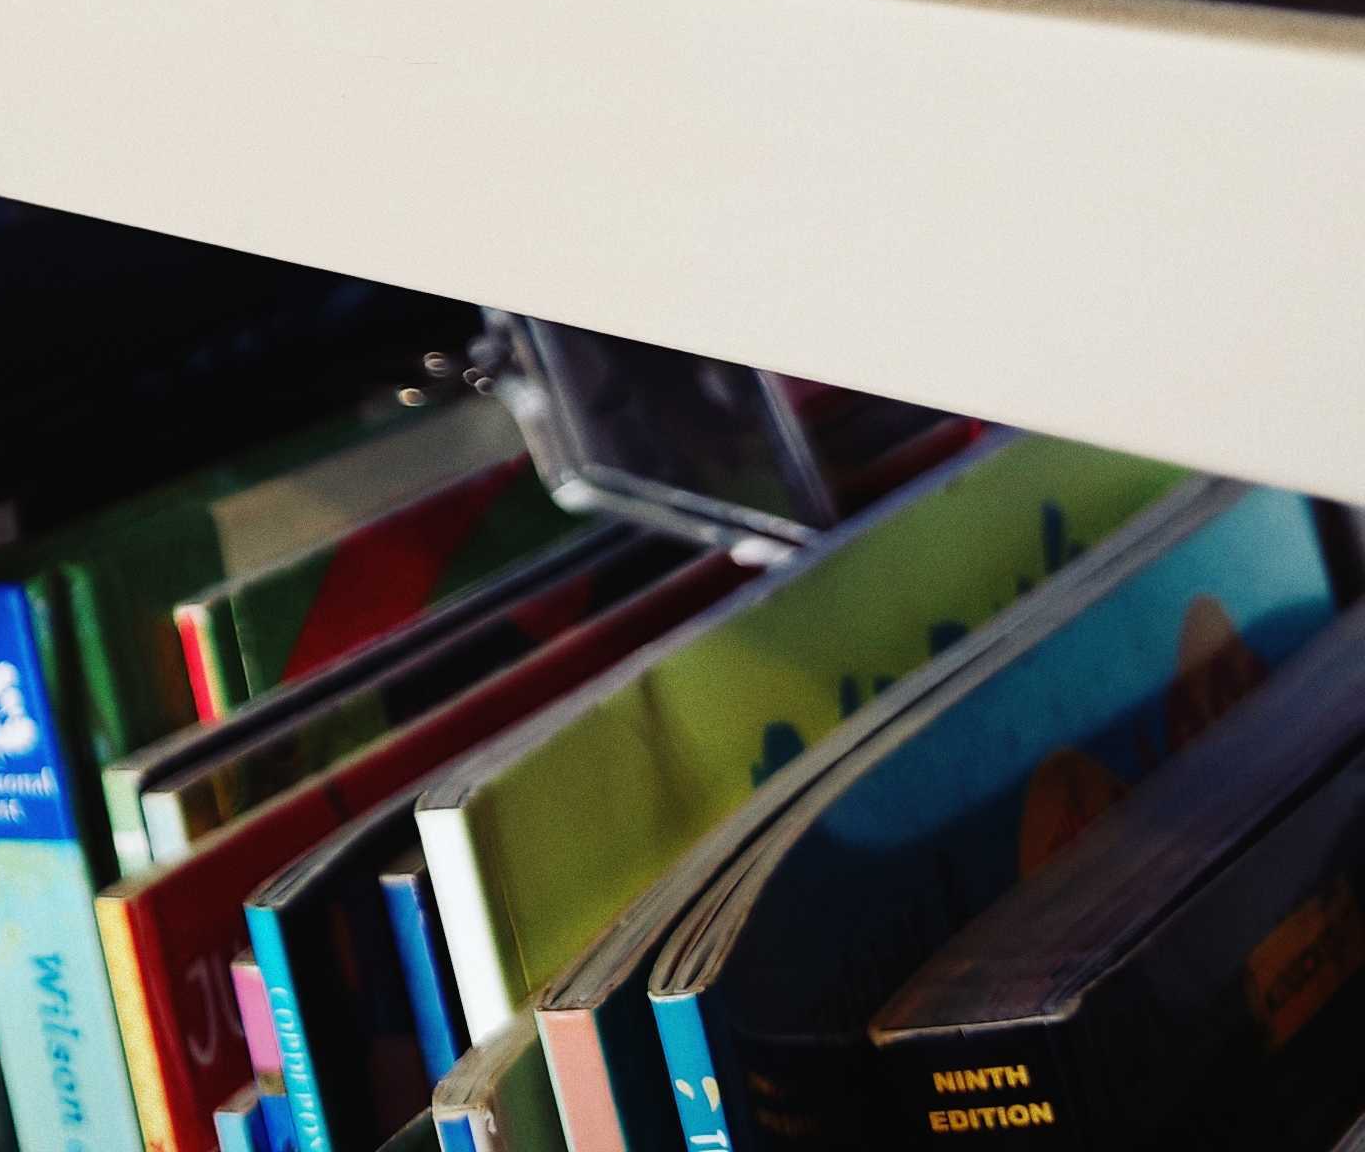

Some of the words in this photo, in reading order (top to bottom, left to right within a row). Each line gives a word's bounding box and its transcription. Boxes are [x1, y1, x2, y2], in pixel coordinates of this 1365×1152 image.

[32, 952, 85, 1128] Wilson
[932, 1064, 1031, 1094] NINTH
[928, 1101, 1055, 1134] EDITION
